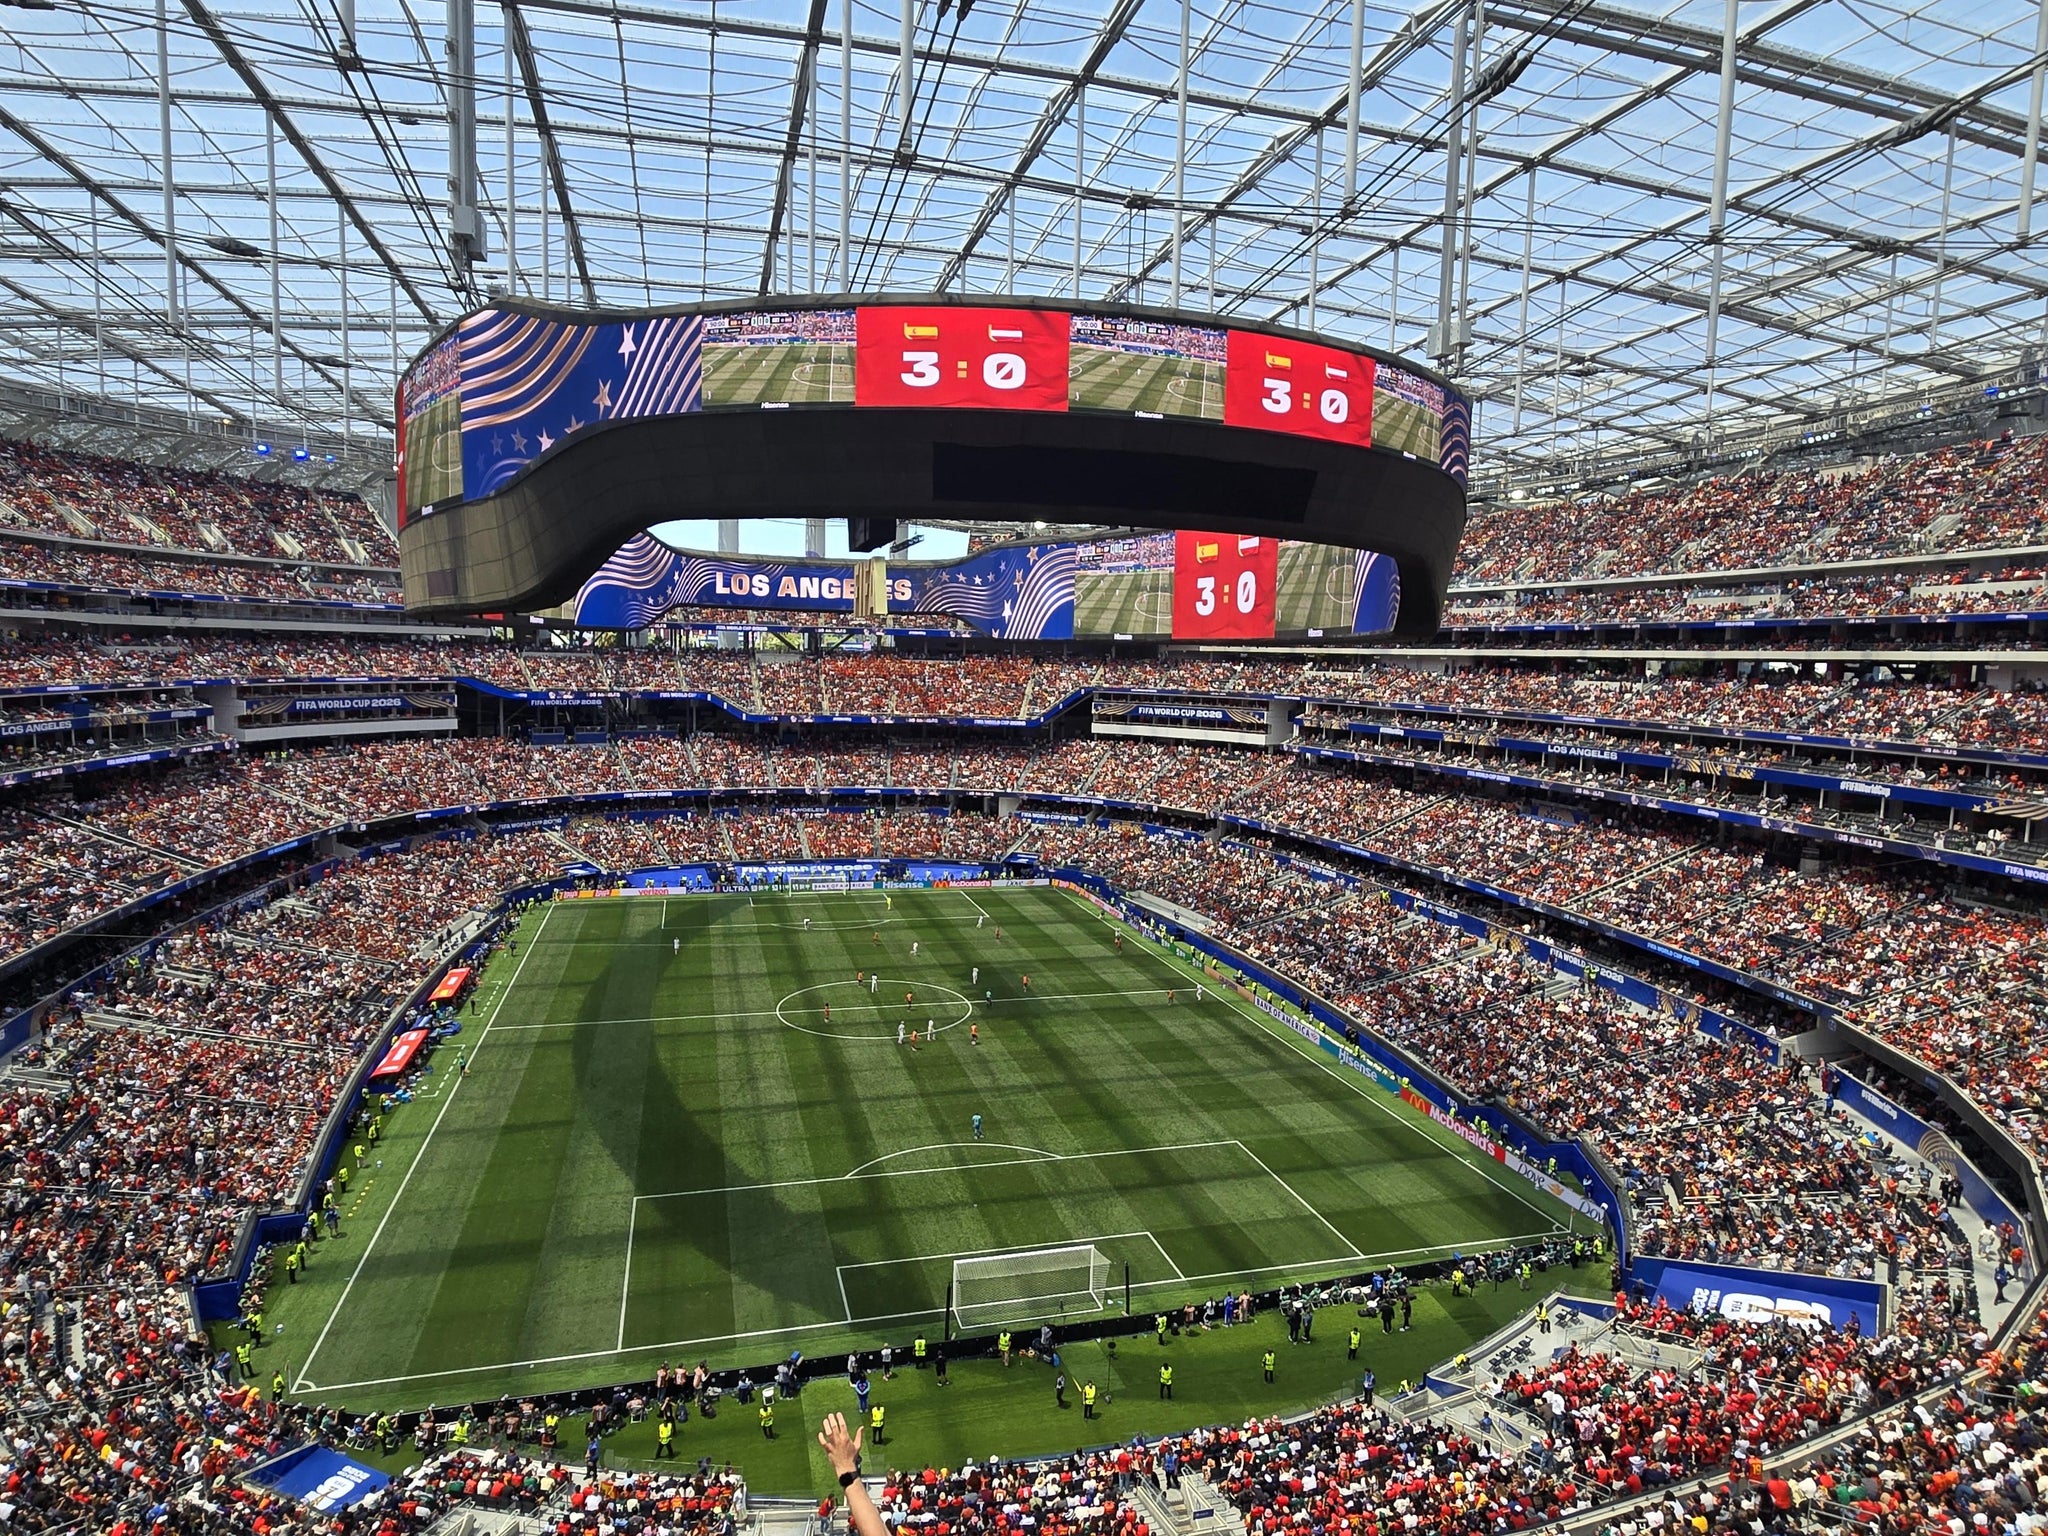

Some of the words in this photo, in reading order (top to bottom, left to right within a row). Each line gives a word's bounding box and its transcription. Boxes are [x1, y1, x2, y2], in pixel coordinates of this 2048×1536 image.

[900, 351, 940, 387] 3
[982, 353, 1027, 389] 0
[1262, 377, 1292, 414] 3
[1320, 389, 1349, 424] 0
[715, 571, 771, 597] LOS
[1195, 576, 1216, 617] 3
[1236, 570, 1257, 614] 0
[296, 700, 317, 710] FIFA
[318, 699, 351, 709] WORLD
[352, 698, 371, 708] CUP
[371, 698, 402, 708] 2026
[1138, 707, 1154, 715] FIFA
[1154, 707, 1181, 716] WORLD
[1181, 708, 1195, 717] CUP
[1195, 709, 1223, 719] 2026
[2, 725, 24, 736] LOS
[25, 720, 73, 733] ANGELES
[1548, 744, 1567, 754] LOS
[1569, 746, 1618, 760] ANGELES
[1840, 780, 1891, 798] #FIFAWorldCup
[767, 865, 809, 873] WORLD
[2005, 865, 2024, 877] FIFA
[2024, 869, 2048, 882] WOR
[638, 887, 669, 896] verizon
[722, 885, 750, 893] ULTRA
[882, 881, 924, 889] Hisense
[1563, 953, 1586, 968] WORLD
[1256, 997, 1273, 1014] BANK
[1272, 1008, 1281, 1018] OF
[1281, 1014, 1310, 1038] AMERICA
[1338, 1047, 1378, 1082] Hisense
[1429, 1104, 1496, 1157] McDonald's
[1517, 1162, 1545, 1186] Dove
[1579, 1200, 1605, 1220] Dov
